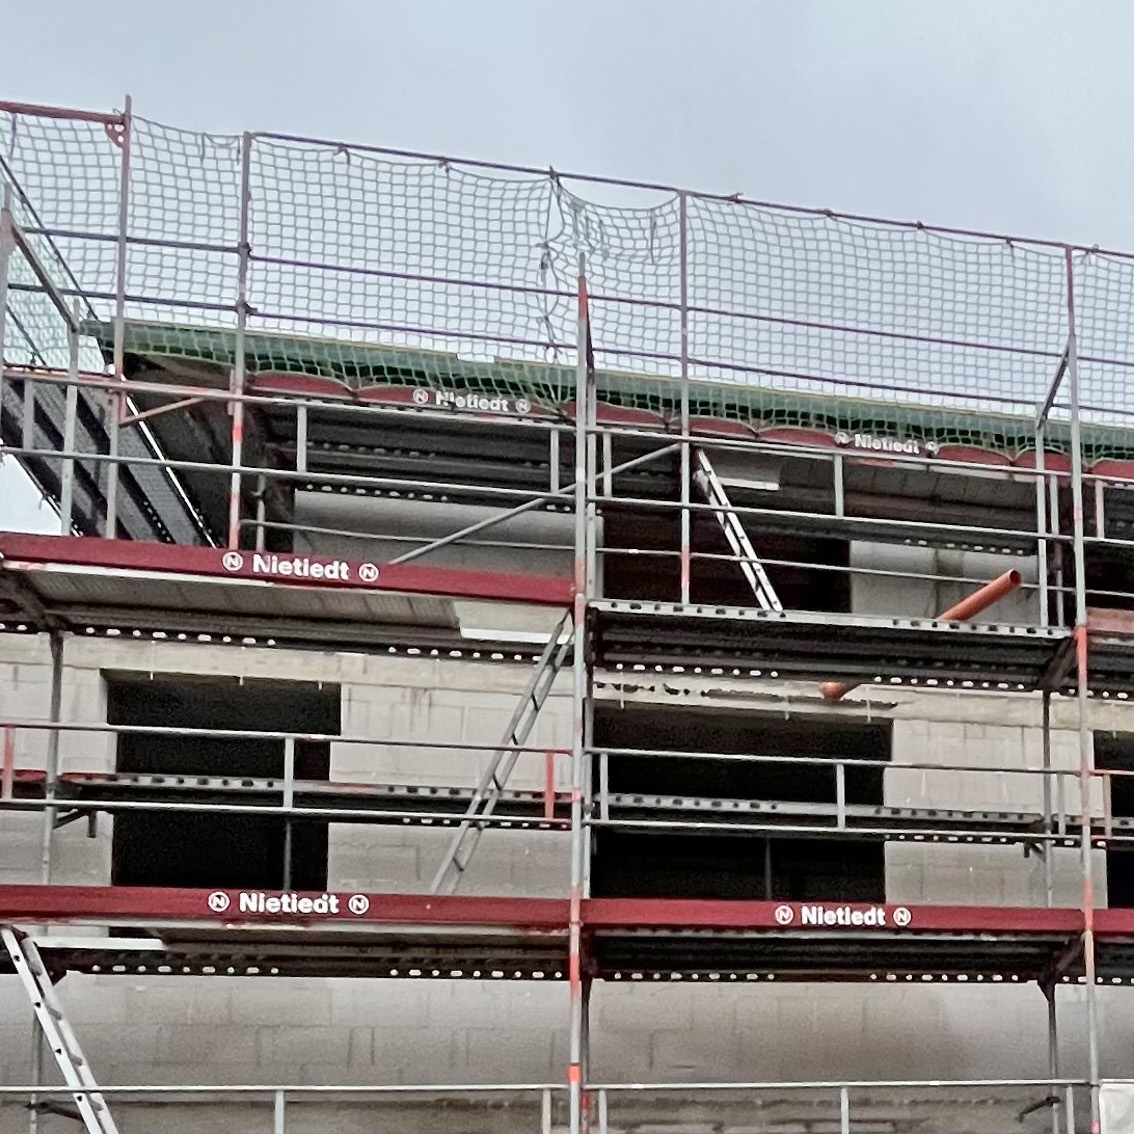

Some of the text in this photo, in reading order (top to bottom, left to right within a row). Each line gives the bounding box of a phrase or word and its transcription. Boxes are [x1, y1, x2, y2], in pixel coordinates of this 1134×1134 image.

[253, 554, 350, 580] Nietiedt
[240, 893, 340, 913] Nietiedt
[802, 906, 887, 925] Nietiedt
